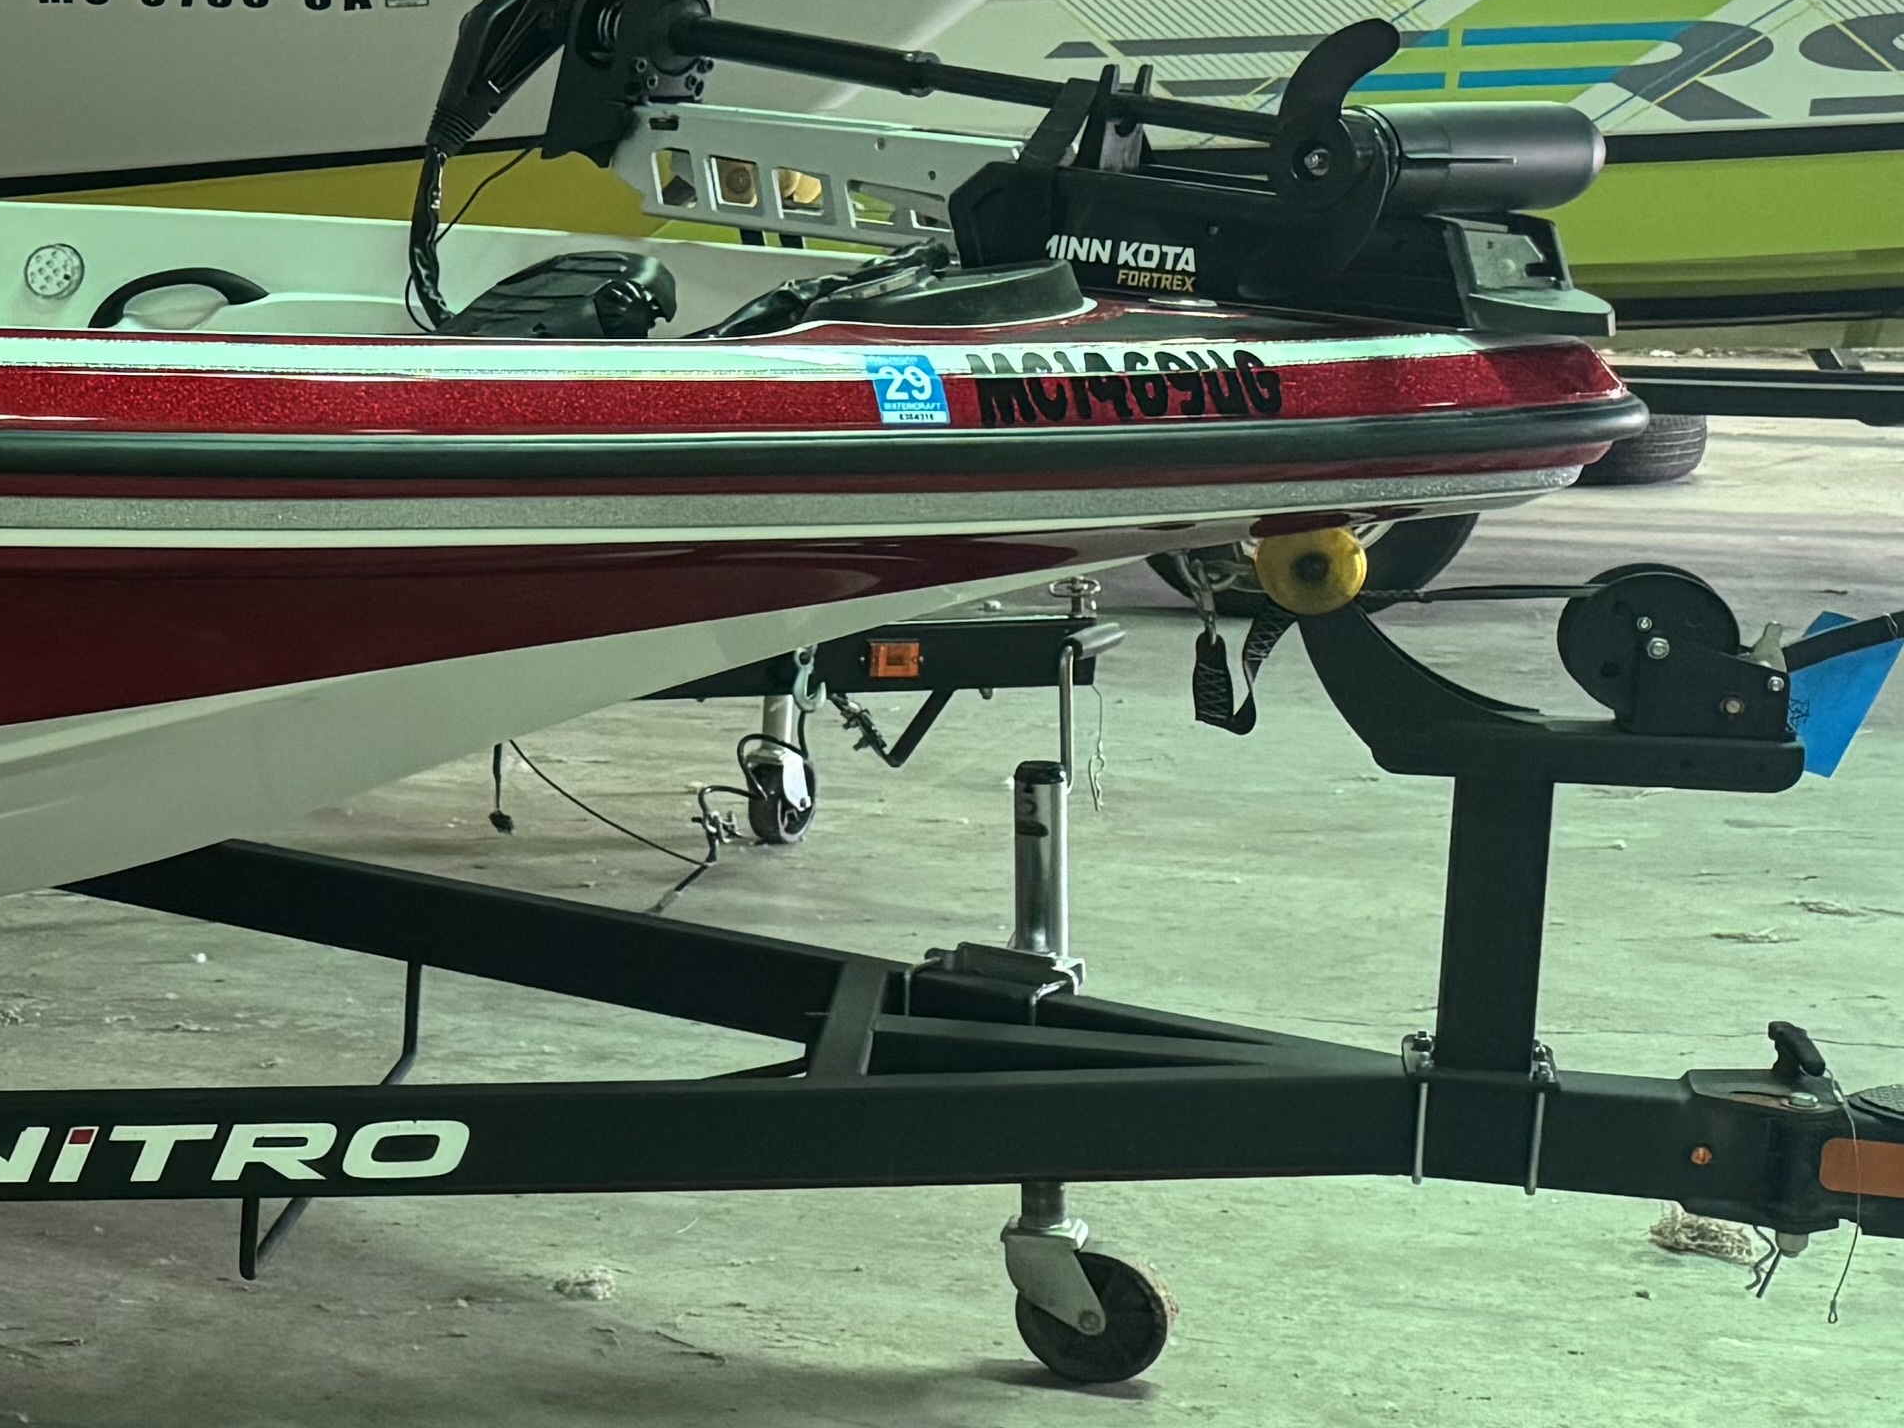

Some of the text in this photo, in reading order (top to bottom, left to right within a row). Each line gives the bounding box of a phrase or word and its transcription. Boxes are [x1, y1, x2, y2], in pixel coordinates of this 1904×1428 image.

[1117, 240, 1197, 273] KOTA
[1116, 269, 1197, 293] FORTREX
[878, 365, 933, 402] 29
